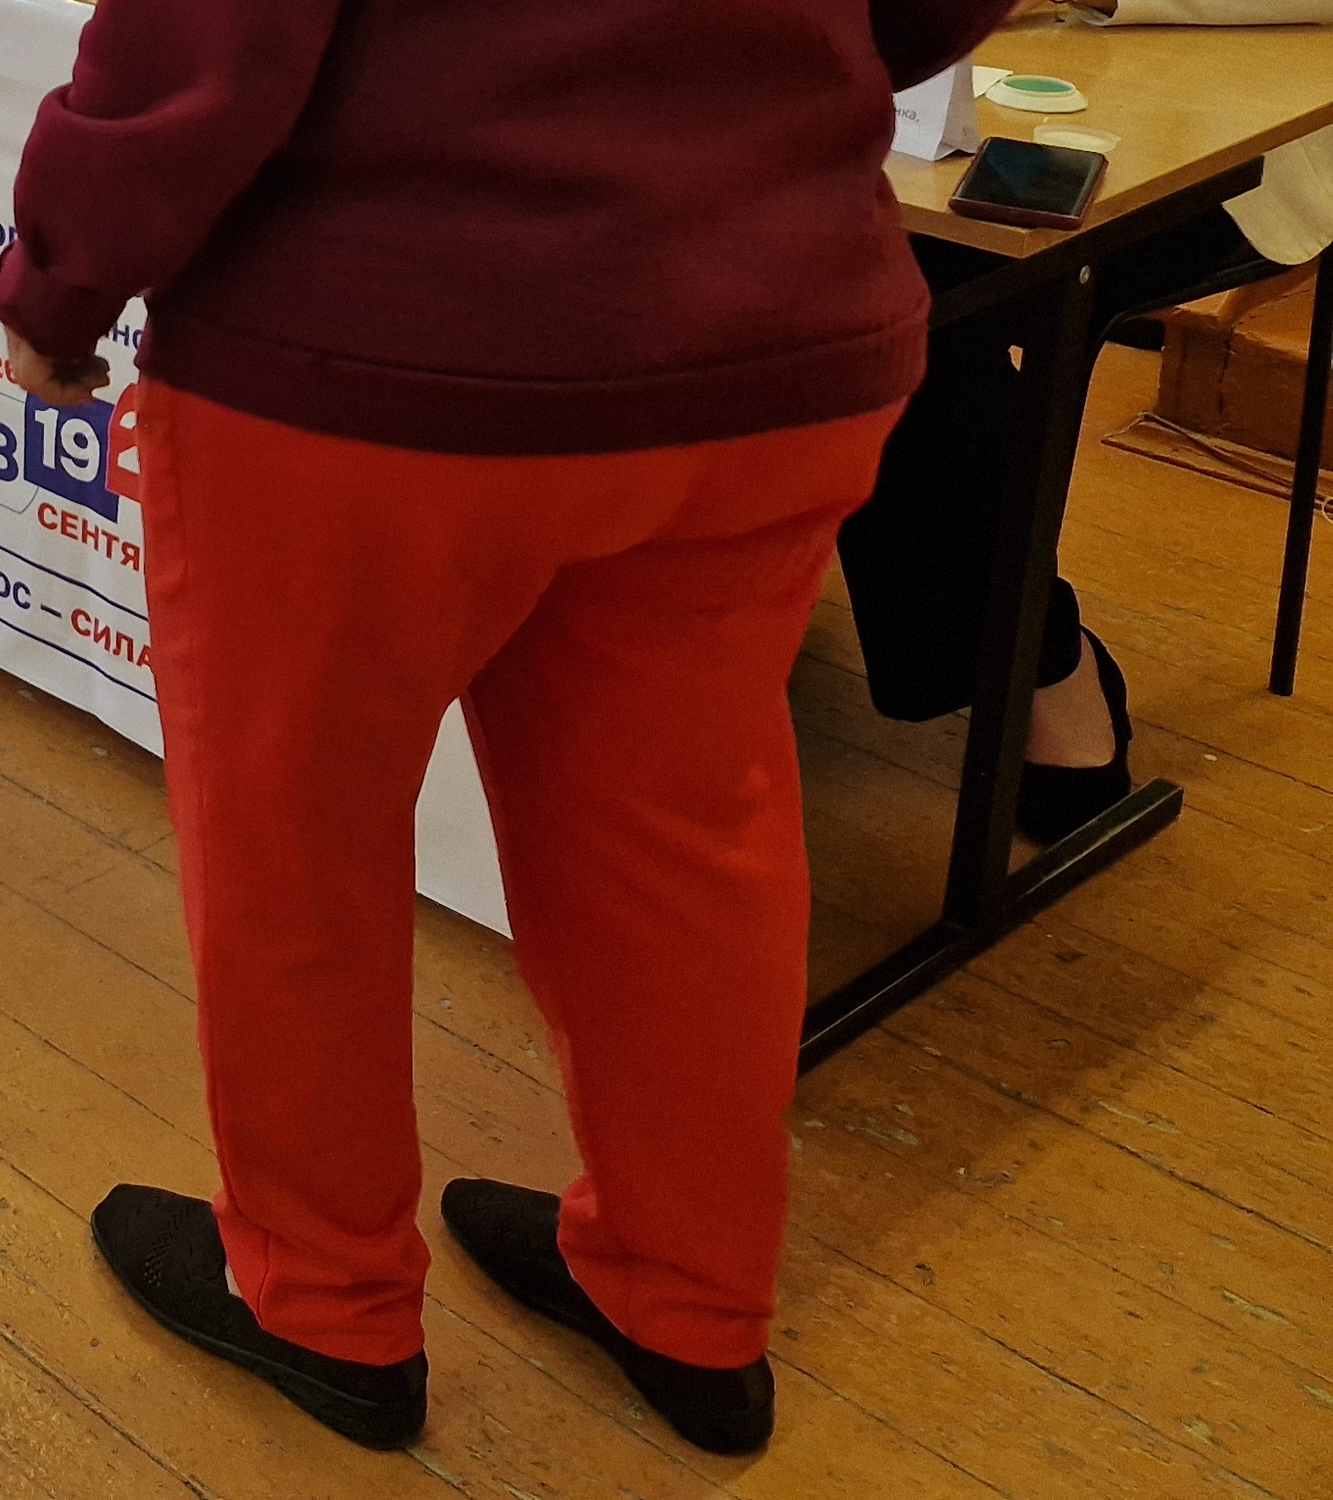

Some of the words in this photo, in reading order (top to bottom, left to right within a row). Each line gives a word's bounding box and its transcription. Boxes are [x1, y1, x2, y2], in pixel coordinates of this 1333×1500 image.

[35, 407, 101, 483] 19
[37, 501, 141, 572] СЕНТЯ
[70, 608, 153, 668] СИЛА
